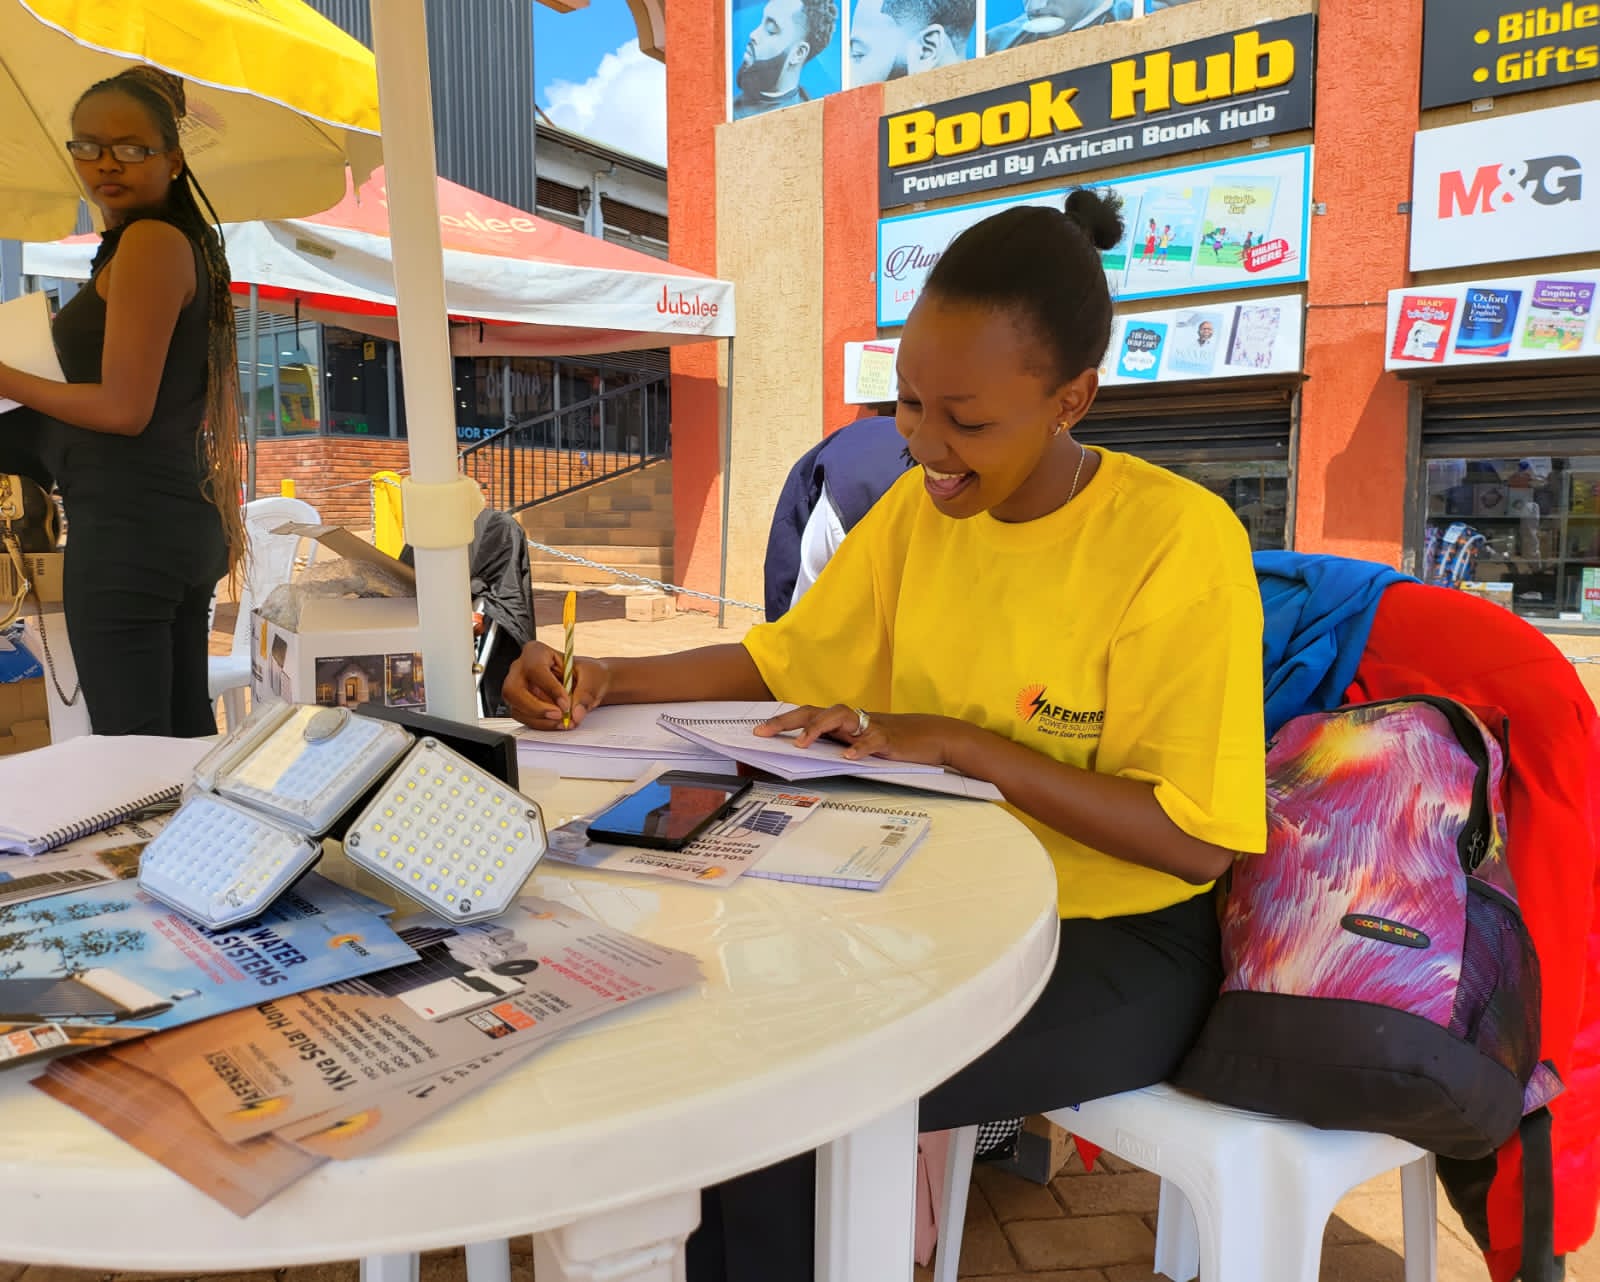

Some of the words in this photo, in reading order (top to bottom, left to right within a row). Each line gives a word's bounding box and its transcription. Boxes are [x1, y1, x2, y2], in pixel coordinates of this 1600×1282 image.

[1498, 1, 1600, 44] Bible
[1496, 45, 1600, 84] Gifts
[887, 80, 1083, 167] Book
[1111, 31, 1294, 120] Hub
[903, 159, 998, 193] Powered
[1005, 154, 1035, 175] By
[1041, 136, 1133, 167] African
[1143, 116, 1210, 146] Book
[1220, 103, 1275, 130] Hub
[1438, 155, 1583, 219] M&G
[657, 284, 719, 317] Jubilee
[895, 288, 915, 303] Let
[1473, 293, 1509, 304] Oxford
[457, 427, 481, 439] UOR
[483, 428, 504, 439] ST
[687, 843, 753, 854] BOREHO
[213, 936, 289, 987] SYSTEMS
[248, 928, 308, 968] WATER
[282, 1029, 326, 1061] Solar
[313, 1057, 358, 1091] 1Kva
